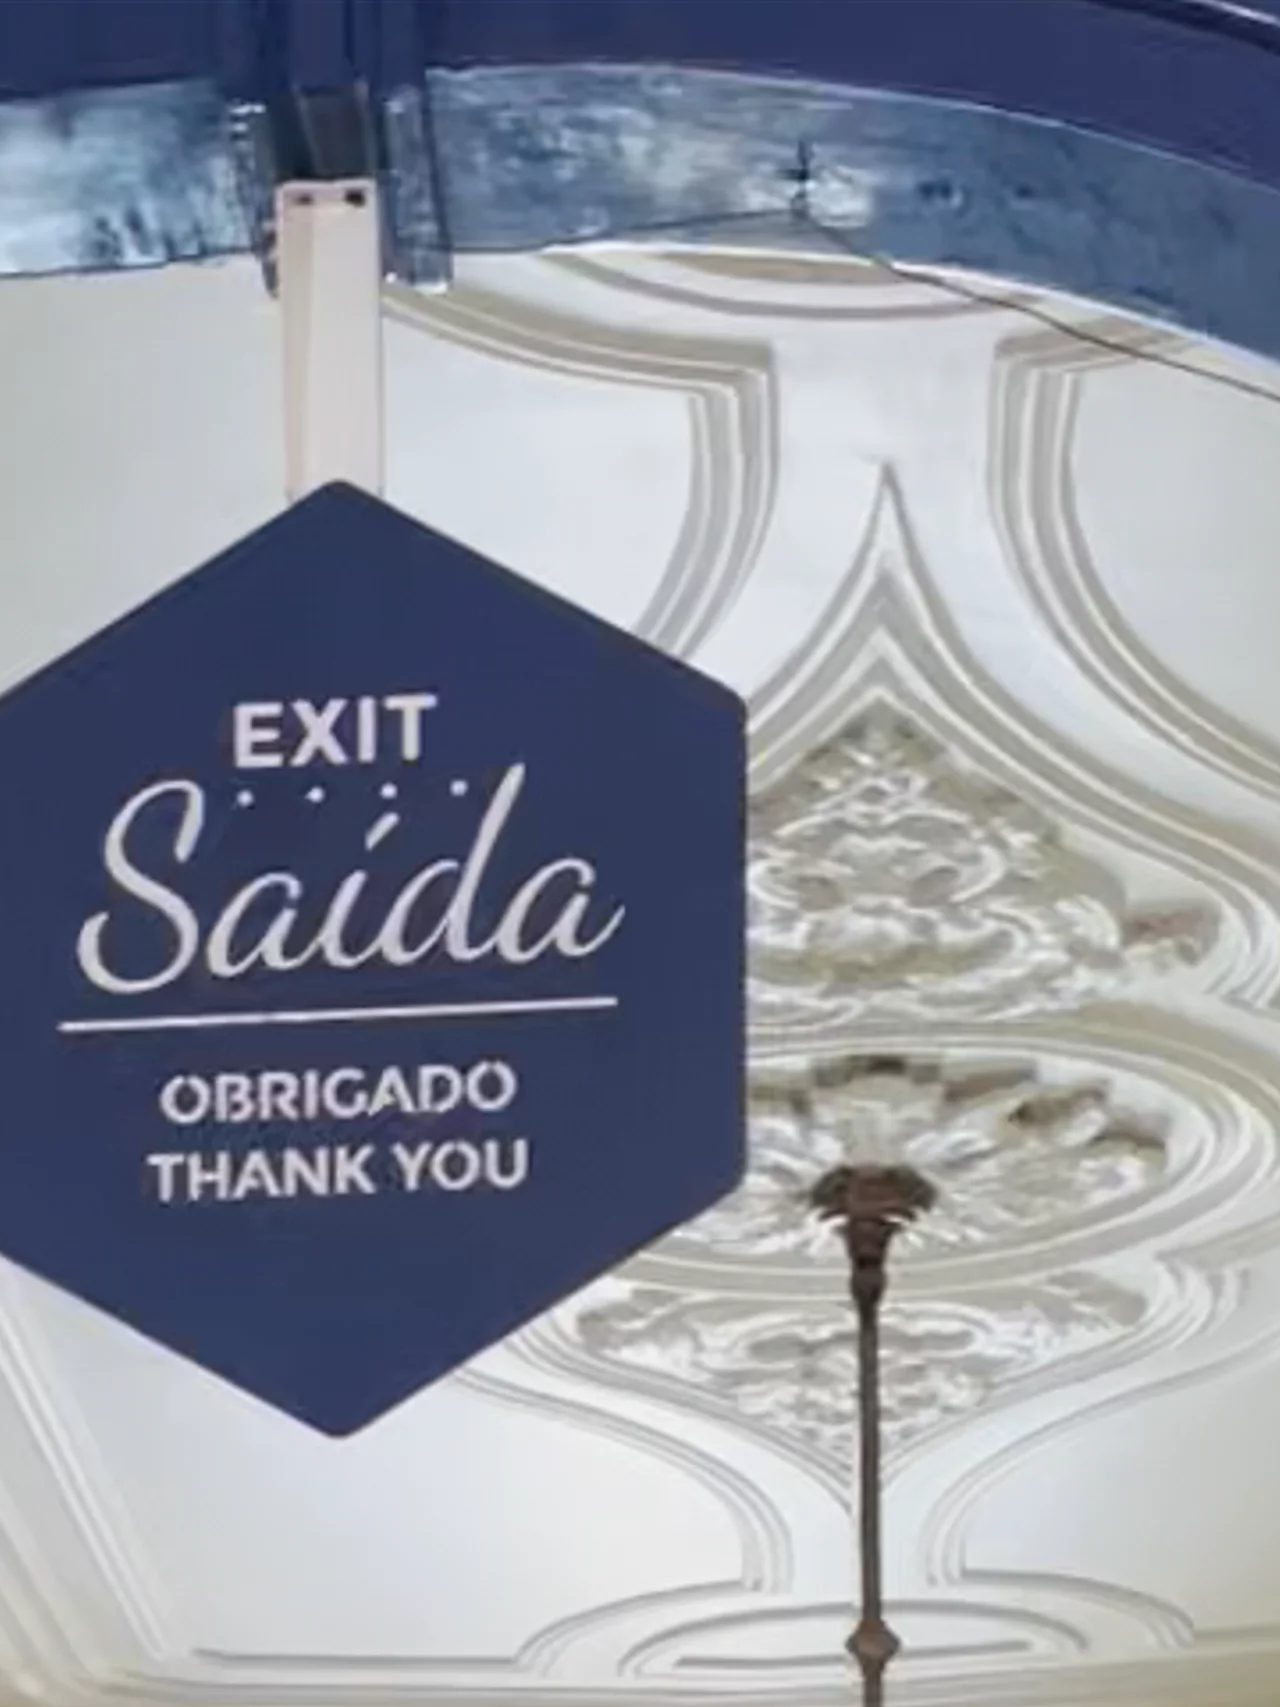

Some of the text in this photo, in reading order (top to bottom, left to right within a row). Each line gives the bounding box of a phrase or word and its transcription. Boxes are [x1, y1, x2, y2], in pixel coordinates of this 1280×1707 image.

[232, 692, 439, 769] EXIT
[75, 761, 627, 995] Saída
[159, 1060, 518, 1125] OBRIGADO
[145, 1137, 529, 1203] THANK YOU
